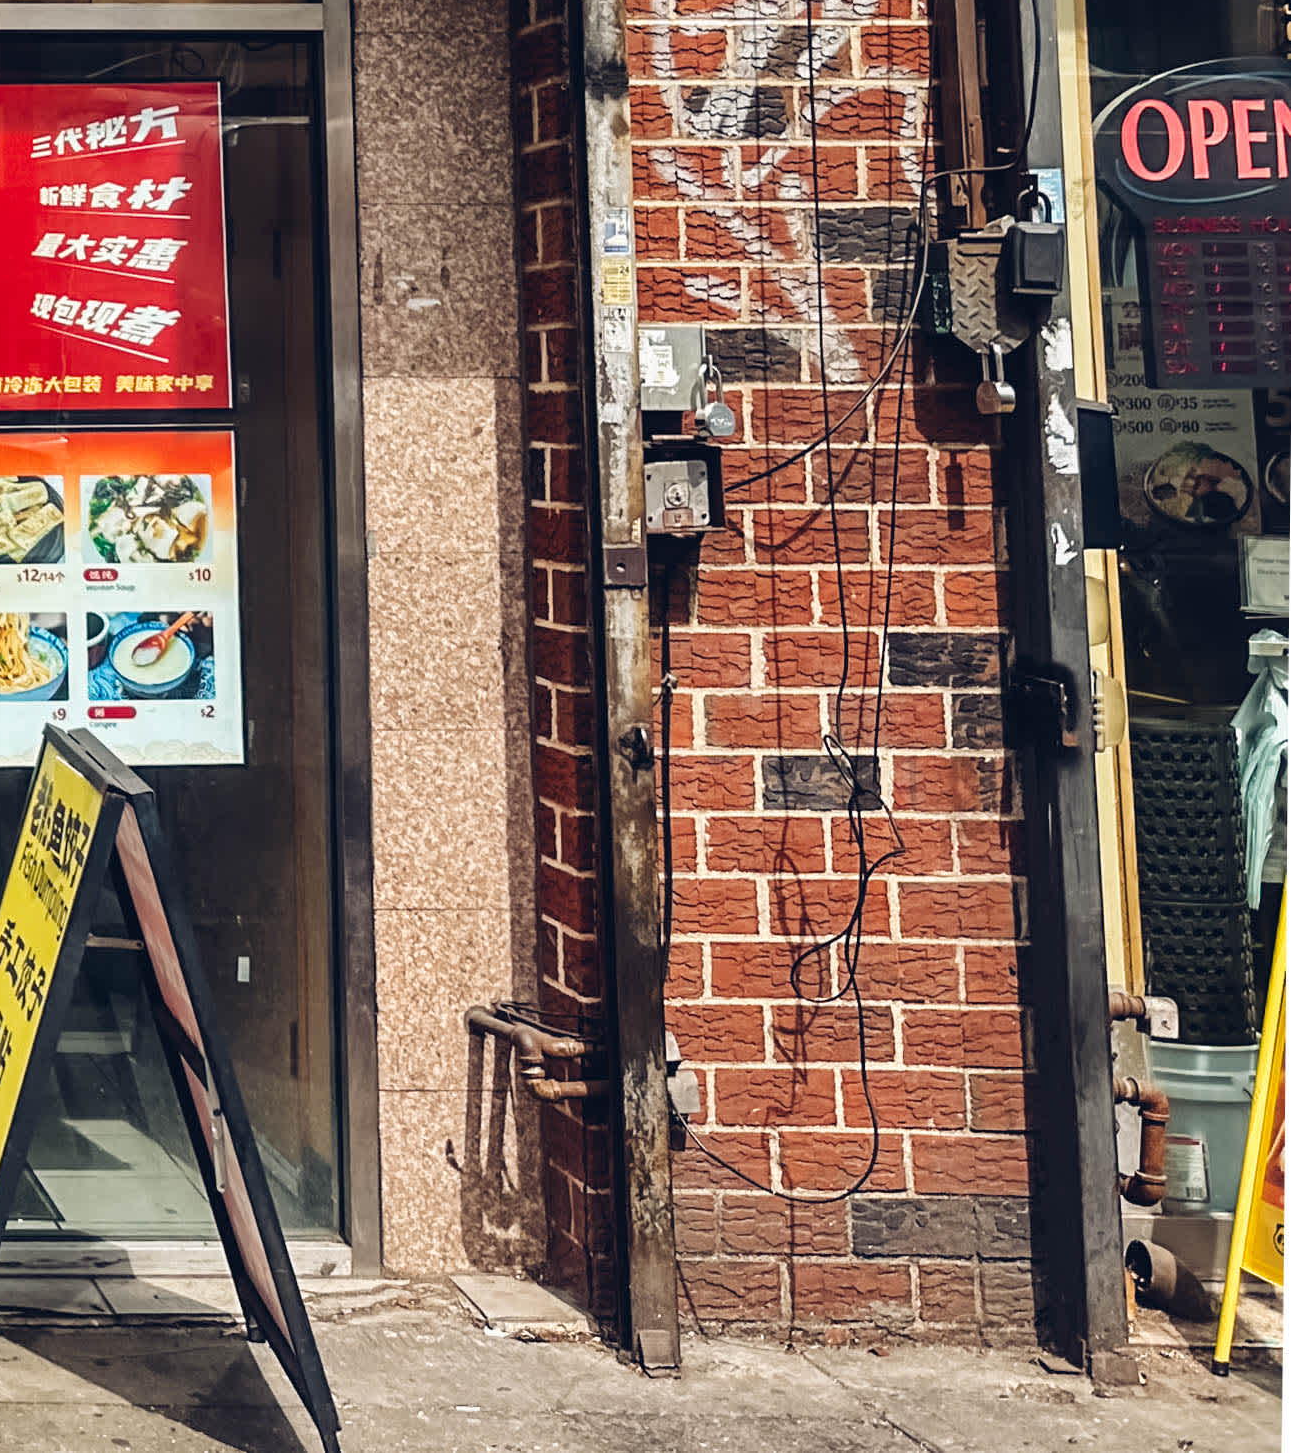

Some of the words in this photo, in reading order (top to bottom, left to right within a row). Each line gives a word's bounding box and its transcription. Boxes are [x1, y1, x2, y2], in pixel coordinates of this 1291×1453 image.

[31, 106, 179, 158] 三代秘方
[39, 177, 192, 211] 新鲜食材
[31, 232, 188, 272] 量大实惠
[31, 293, 182, 346] 现包现煮
[115, 374, 214, 394] 美味家中享
[188, 568, 211, 582] $10
[52, 707, 67, 721] $9
[200, 705, 215, 718] $2
[33, 858, 69, 942] Dumpling
